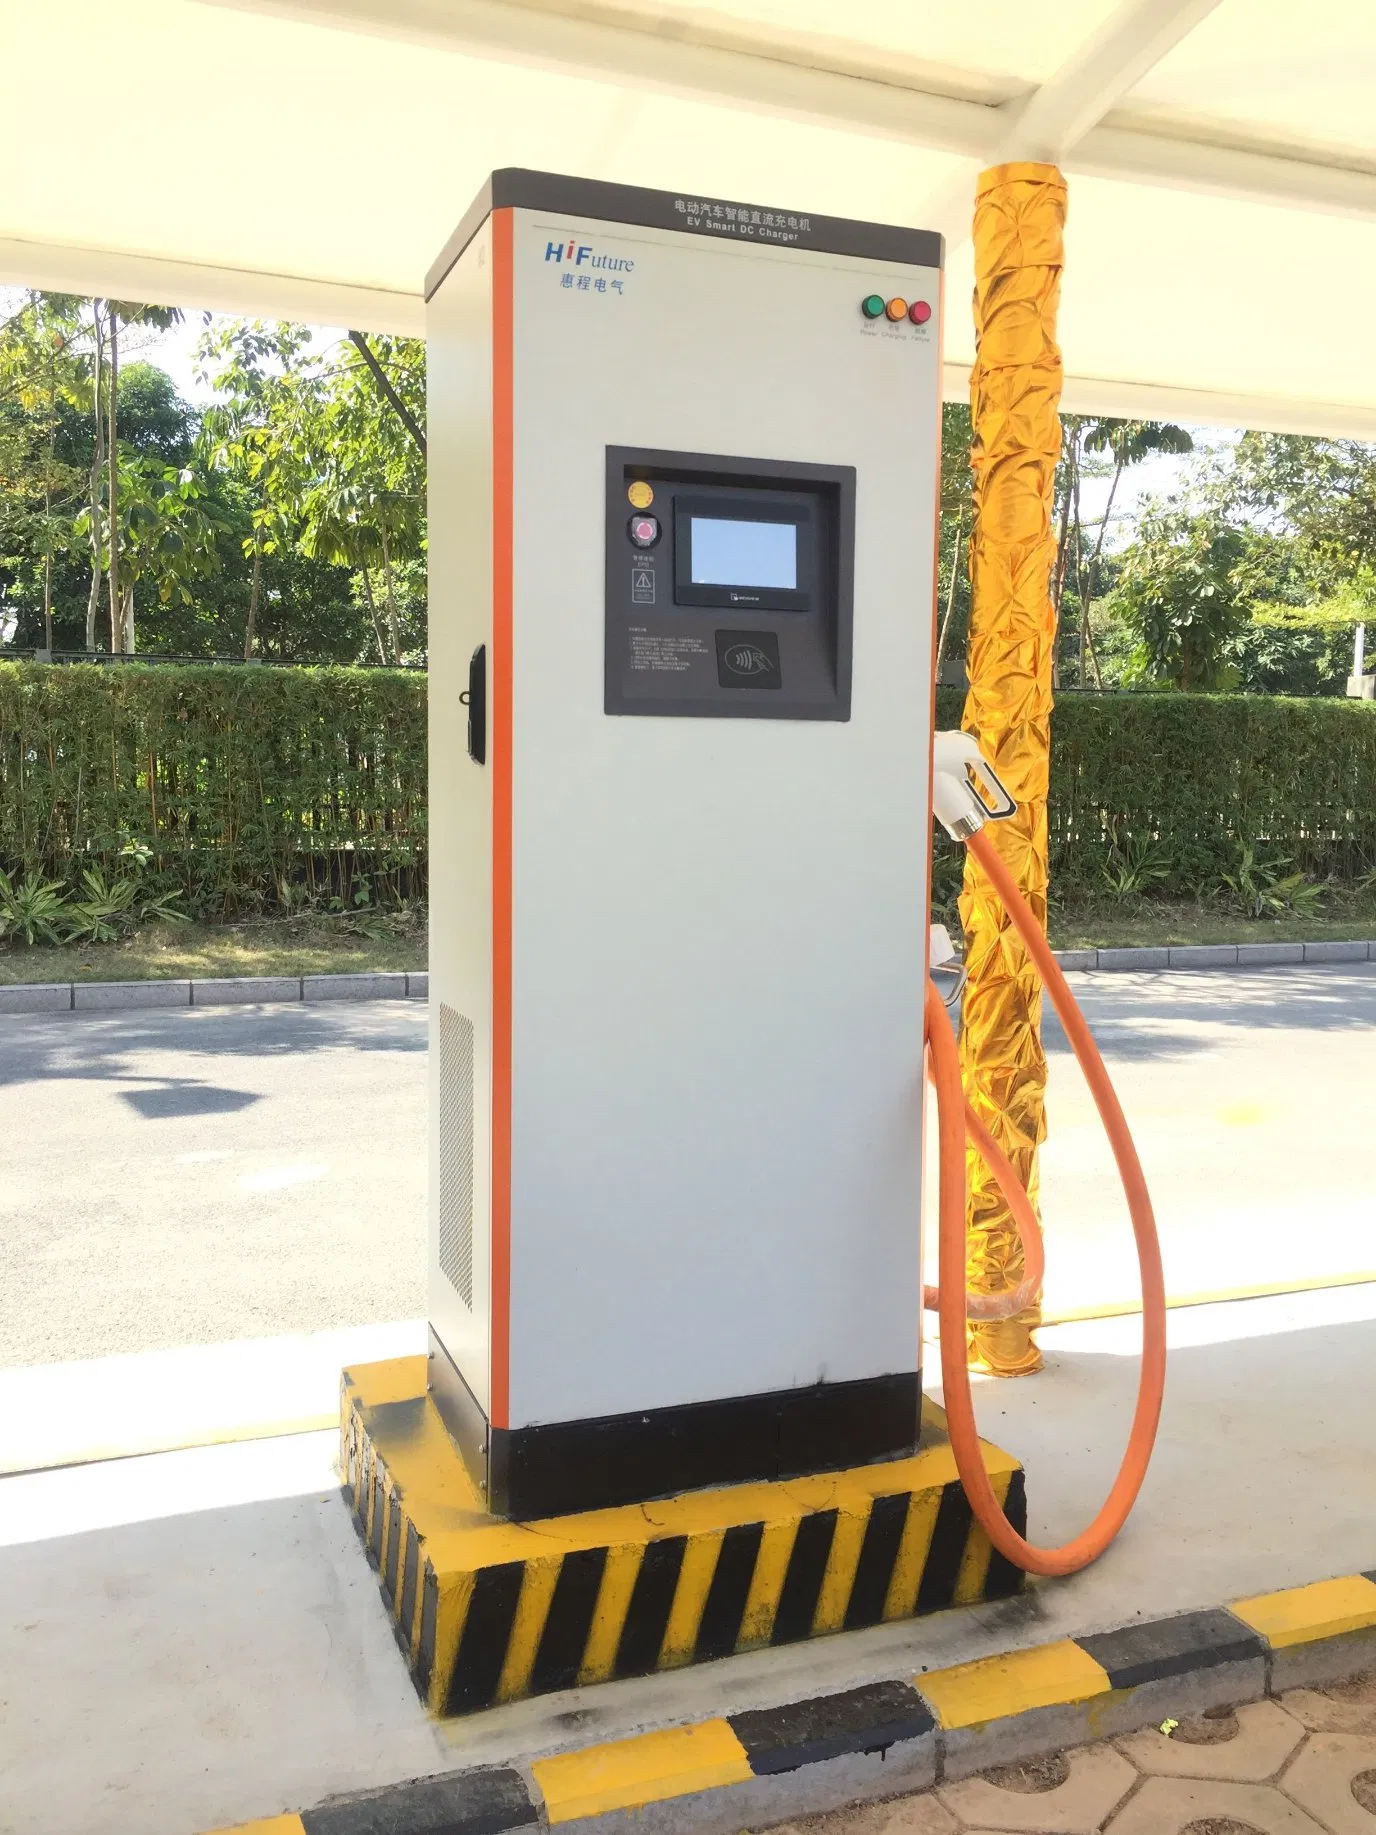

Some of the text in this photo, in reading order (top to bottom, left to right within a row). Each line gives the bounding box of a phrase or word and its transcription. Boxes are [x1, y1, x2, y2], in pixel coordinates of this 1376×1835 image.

[674, 199, 811, 232] 电动汽车智能直流充电机
[687, 216, 799, 241] EV Smart DC Charger
[545, 240, 635, 272] HiFuture
[560, 273, 624, 295] 惠程电气
